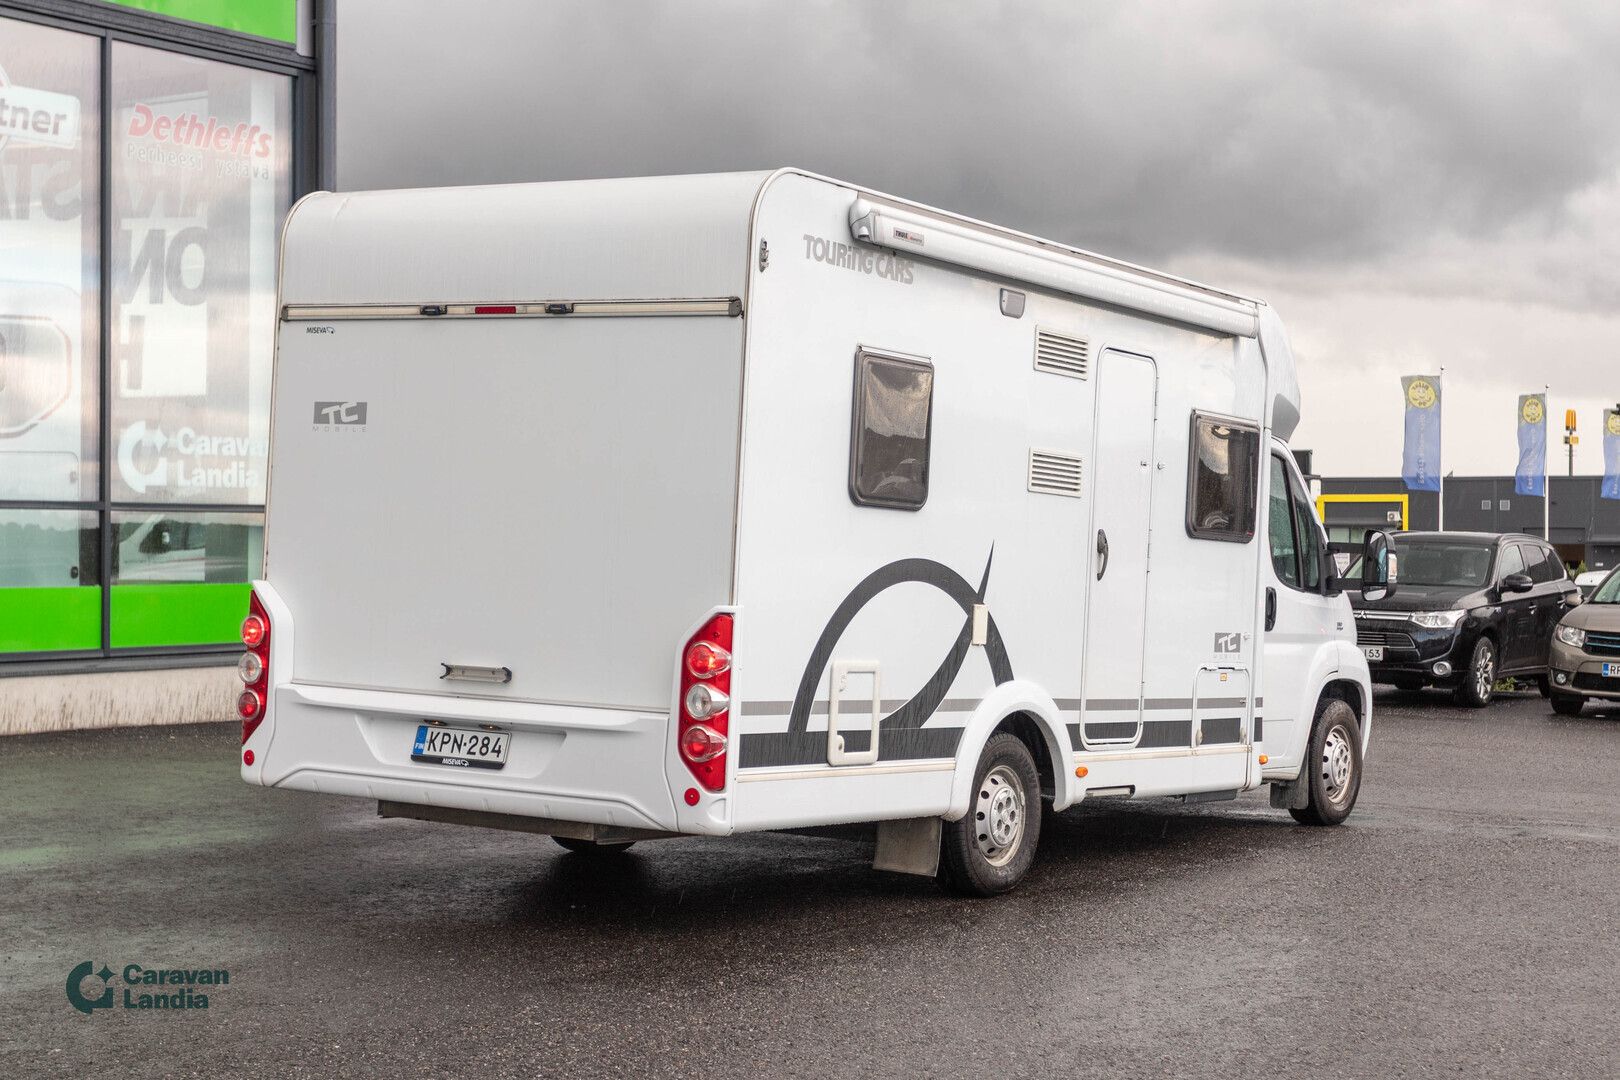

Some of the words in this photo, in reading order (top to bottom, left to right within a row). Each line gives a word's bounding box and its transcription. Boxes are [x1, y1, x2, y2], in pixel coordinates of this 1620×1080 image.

[127, 103, 273, 159] Dethleffs
[875, 250, 914, 285] CARS
[177, 459, 259, 489] Landia
[427, 731, 502, 758] KPN-284
